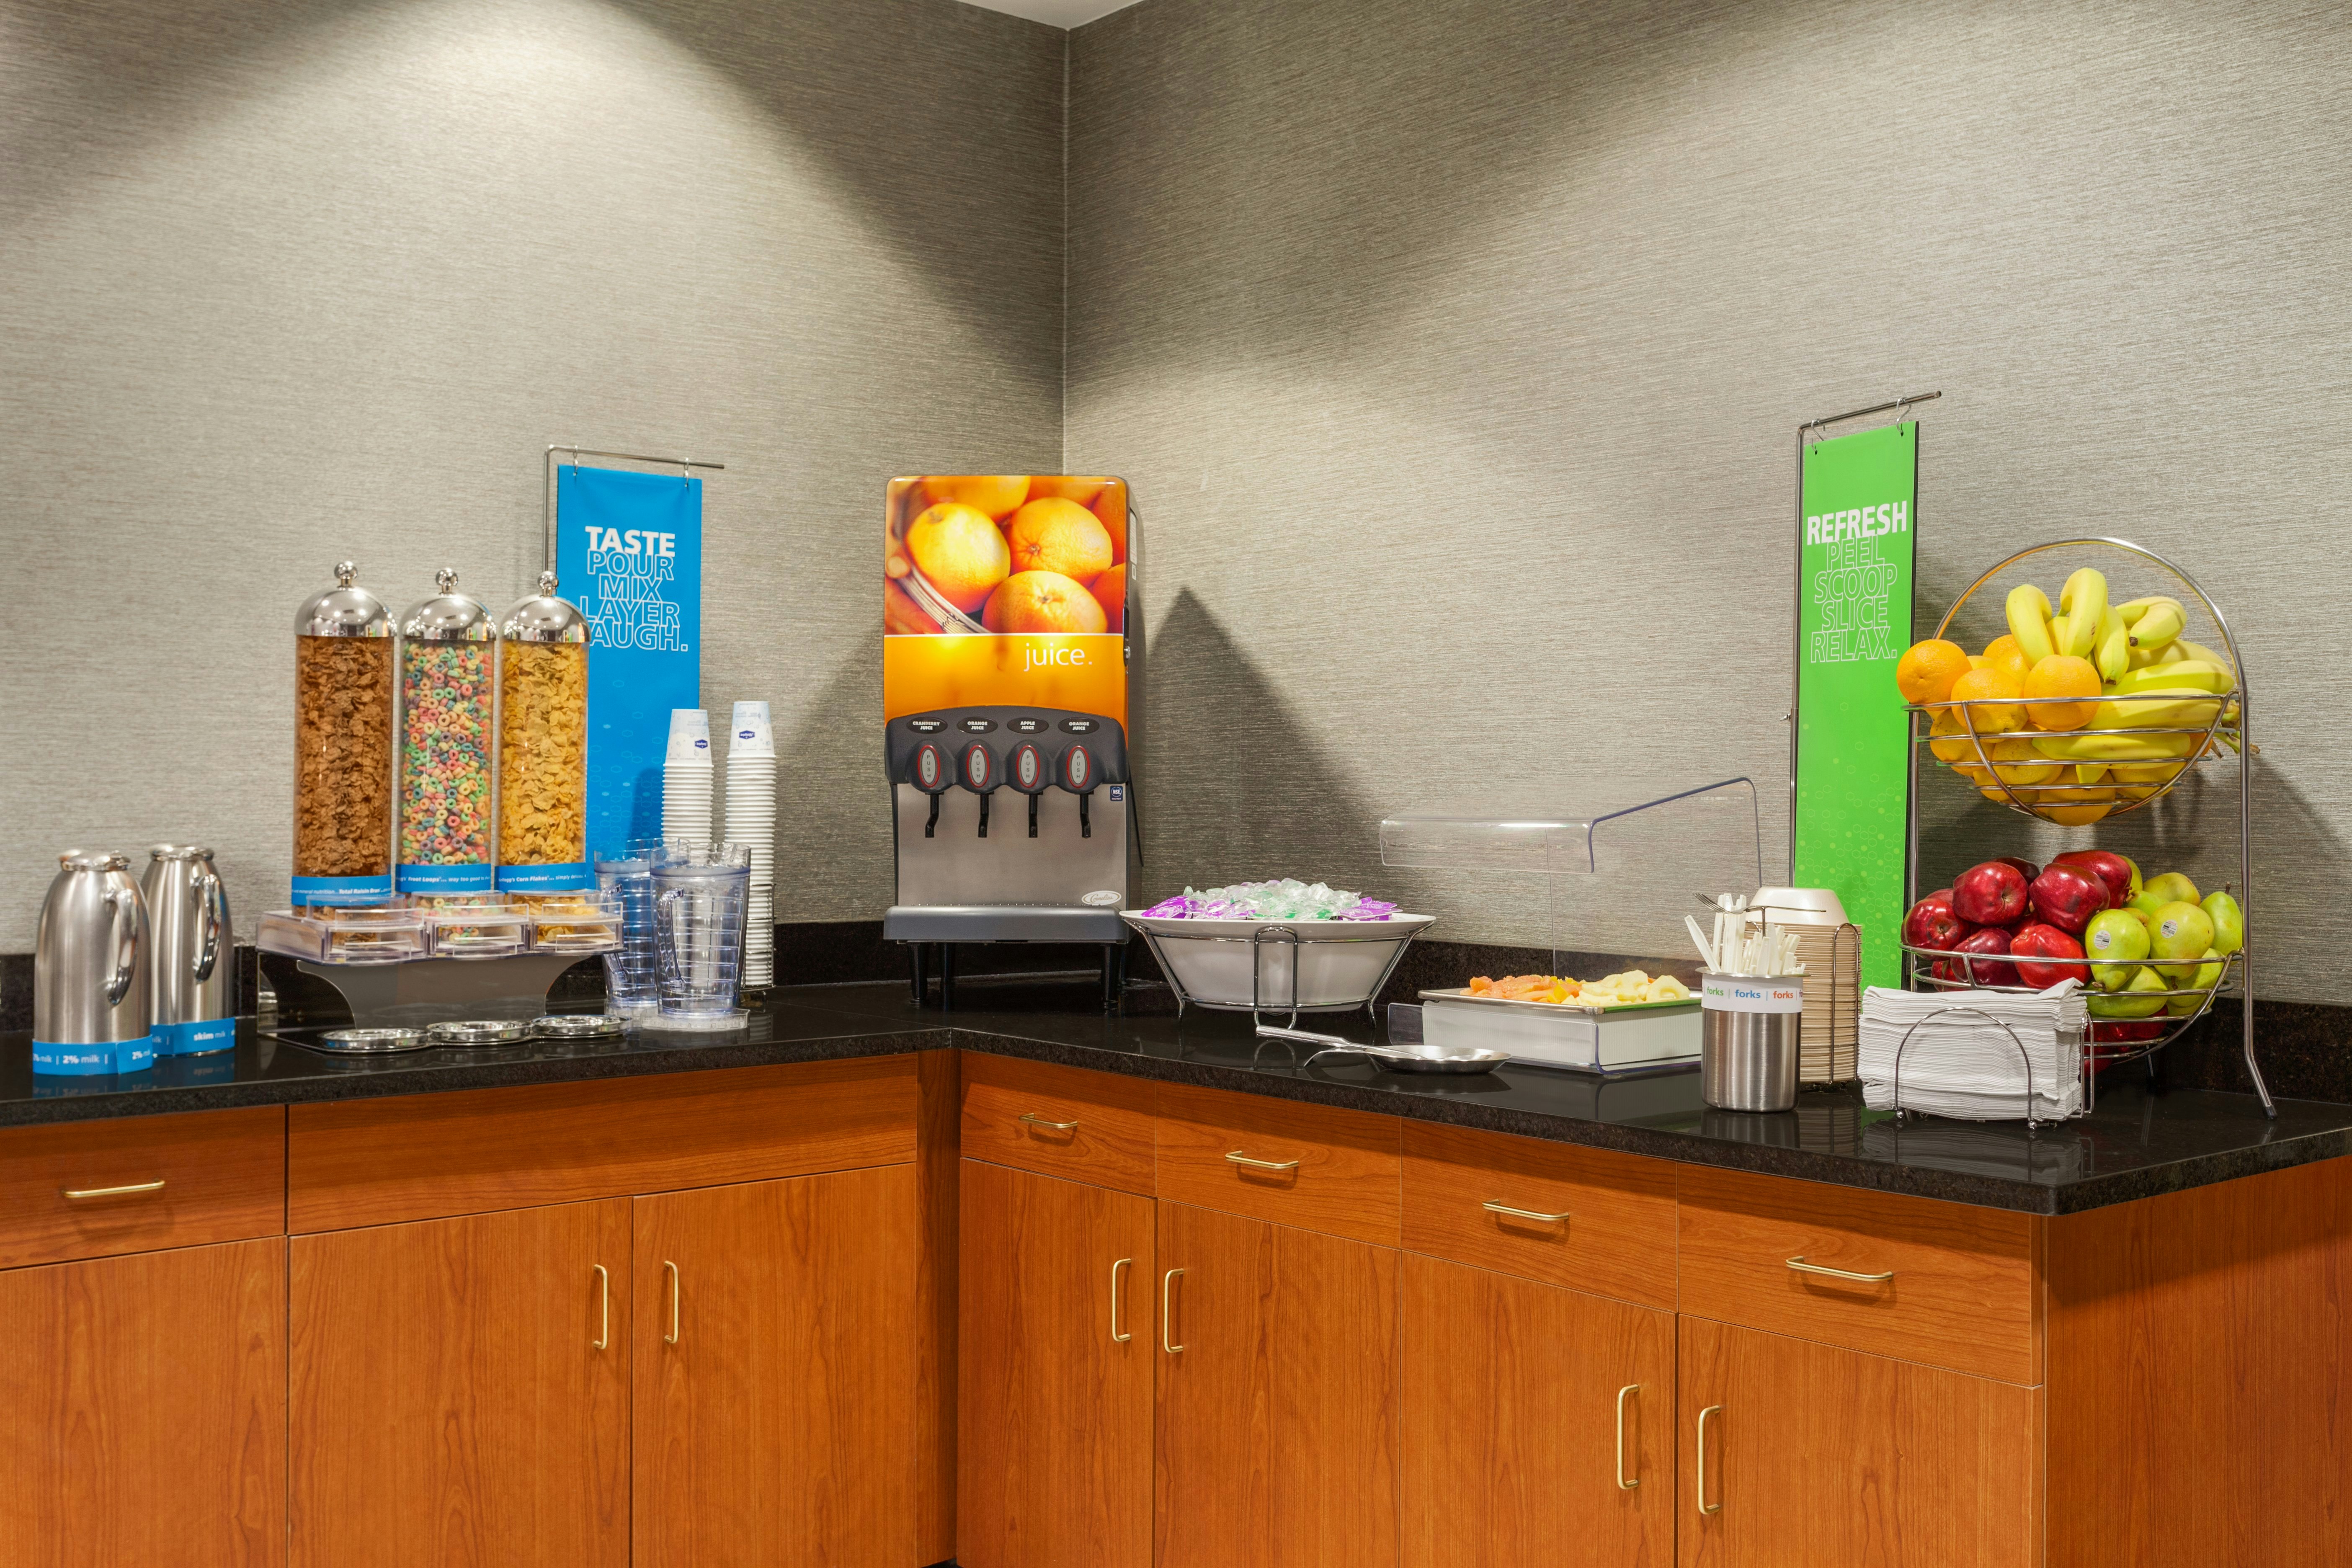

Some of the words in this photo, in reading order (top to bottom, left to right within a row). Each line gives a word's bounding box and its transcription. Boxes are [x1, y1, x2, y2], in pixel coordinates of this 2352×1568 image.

[1807, 500, 1907, 545] REFRESH
[585, 526, 676, 557] TASTE
[1826, 534, 1885, 573] PEEL
[587, 548, 674, 581] POUR
[598, 573, 663, 602] MIX
[1814, 563, 1898, 603] SCOOP
[580, 595, 681, 628] LAYER
[1821, 595, 1888, 633] SLICE
[588, 619, 688, 652] AUGH.
[1810, 626, 1898, 663] RELAX.
[1023, 643, 1093, 672] juice.
[1707, 986, 1724, 996] forks
[1735, 989, 1761, 998] forks
[193, 1032, 214, 1041] skim
[62, 1055, 80, 1064] 2%
[81, 1055, 100, 1063] milk
[132, 1051, 143, 1060] 2%
